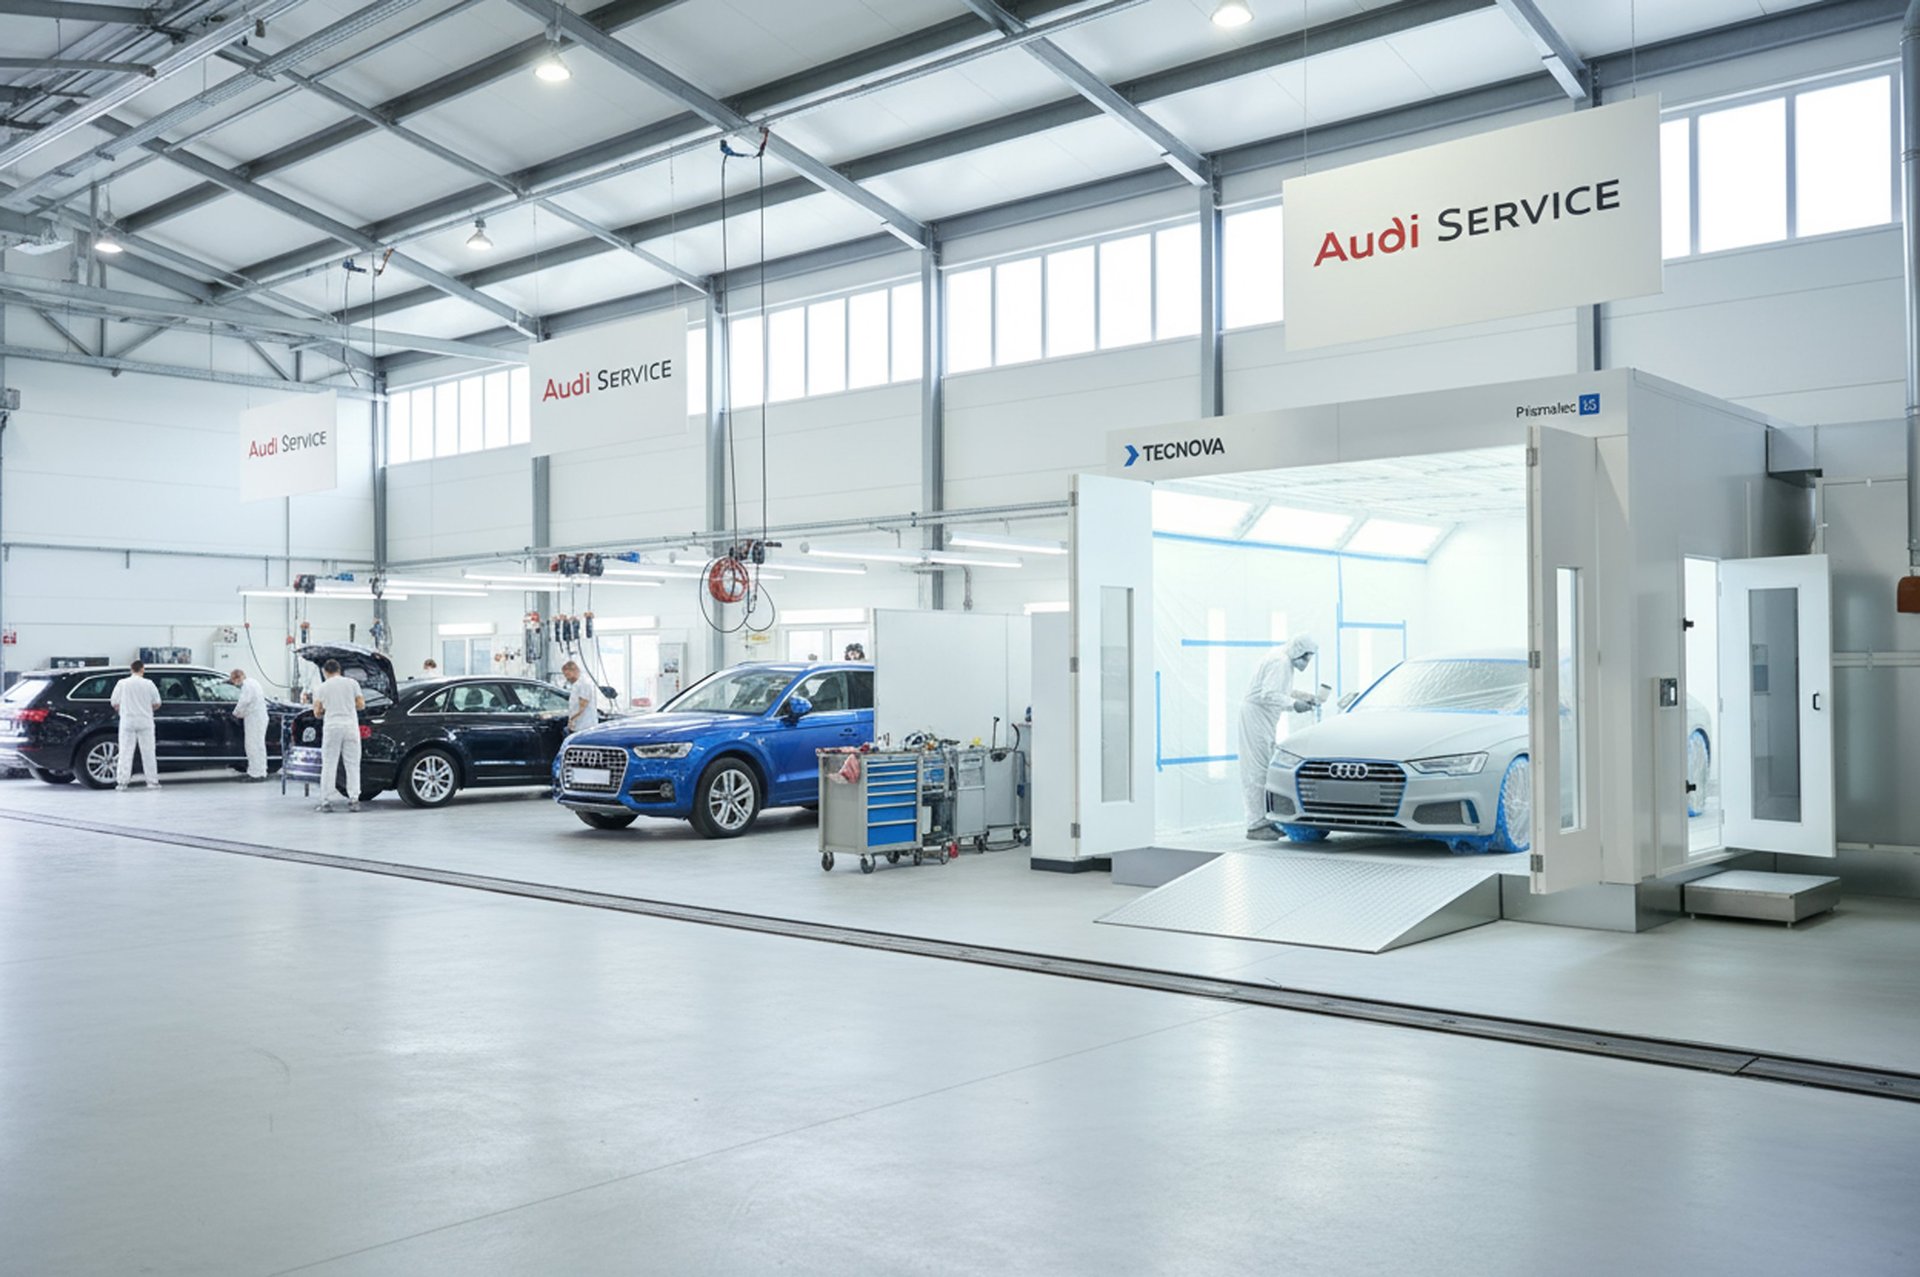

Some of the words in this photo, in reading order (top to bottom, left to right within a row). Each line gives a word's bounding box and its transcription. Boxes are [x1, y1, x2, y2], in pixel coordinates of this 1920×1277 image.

[1313, 214, 1419, 266] Audi
[1437, 179, 1620, 242] SERVICE
[542, 371, 590, 402] Audi
[597, 360, 672, 391] SERVICE
[1142, 437, 1225, 461] TECNOVA
